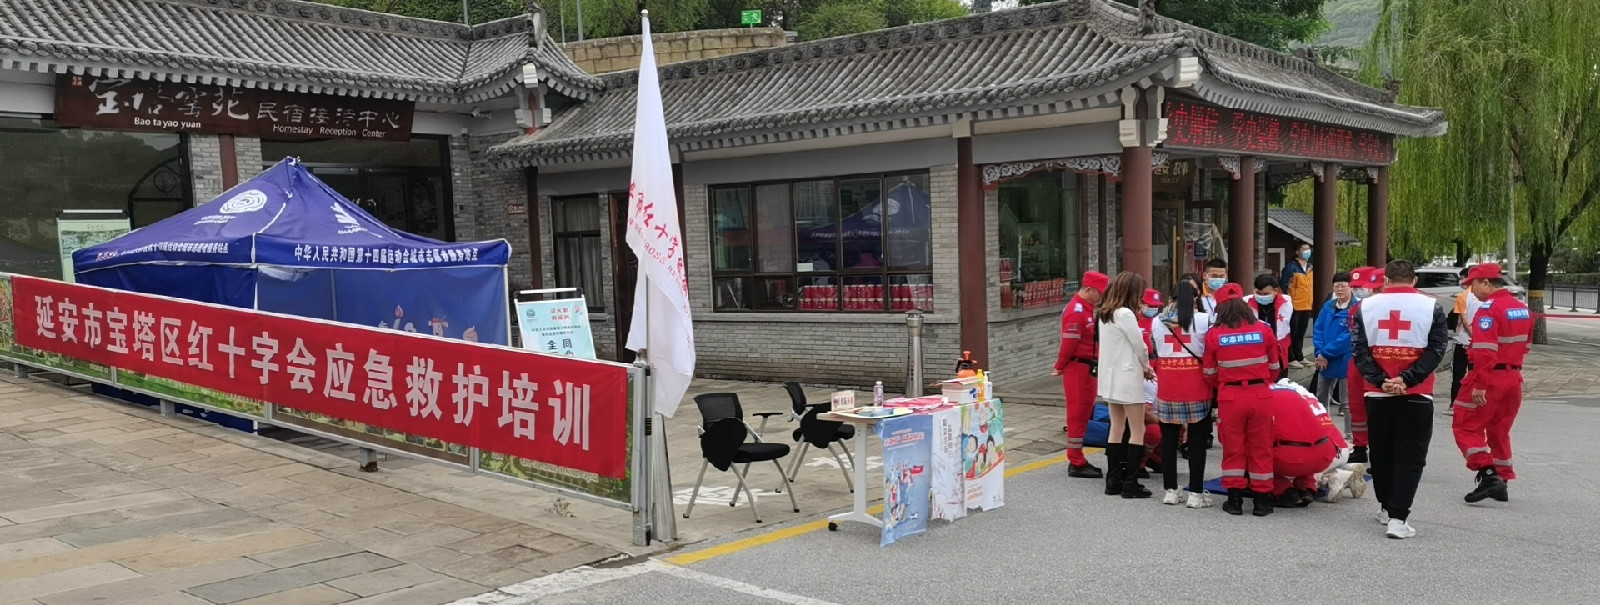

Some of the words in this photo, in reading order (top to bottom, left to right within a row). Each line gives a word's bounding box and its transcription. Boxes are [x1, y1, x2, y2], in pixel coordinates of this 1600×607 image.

[134, 117, 150, 125] Bao
[272, 124, 313, 135] Homestay
[319, 127, 356, 137] Reception
[361, 129, 387, 138] Center
[35, 295, 591, 451] 延安市宝塔区红十字会应急救护培训
